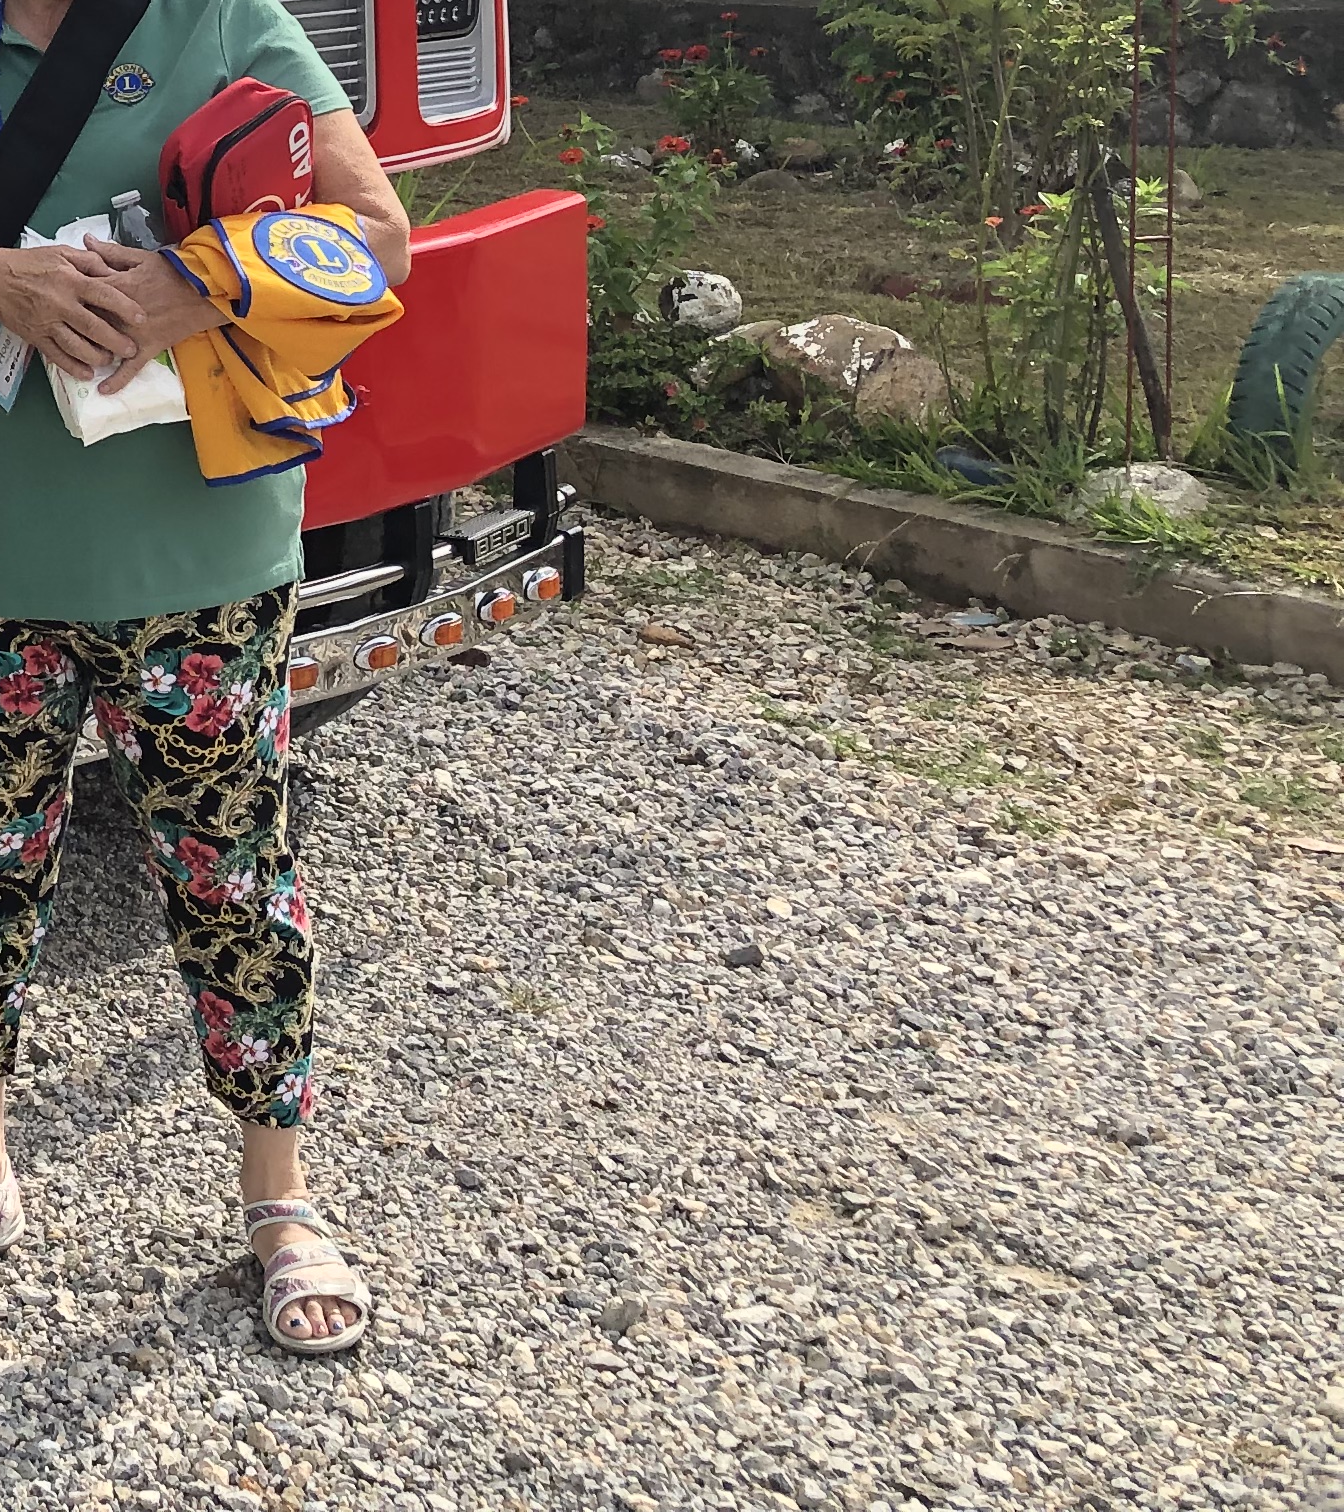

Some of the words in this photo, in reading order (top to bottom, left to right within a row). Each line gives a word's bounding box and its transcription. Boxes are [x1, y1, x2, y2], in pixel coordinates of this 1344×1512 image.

[123, 76, 136, 90] L
[289, 122, 311, 179] AID
[273, 221, 334, 238] LIONS
[302, 239, 344, 268] L
[476, 518, 528, 557] BEPO
